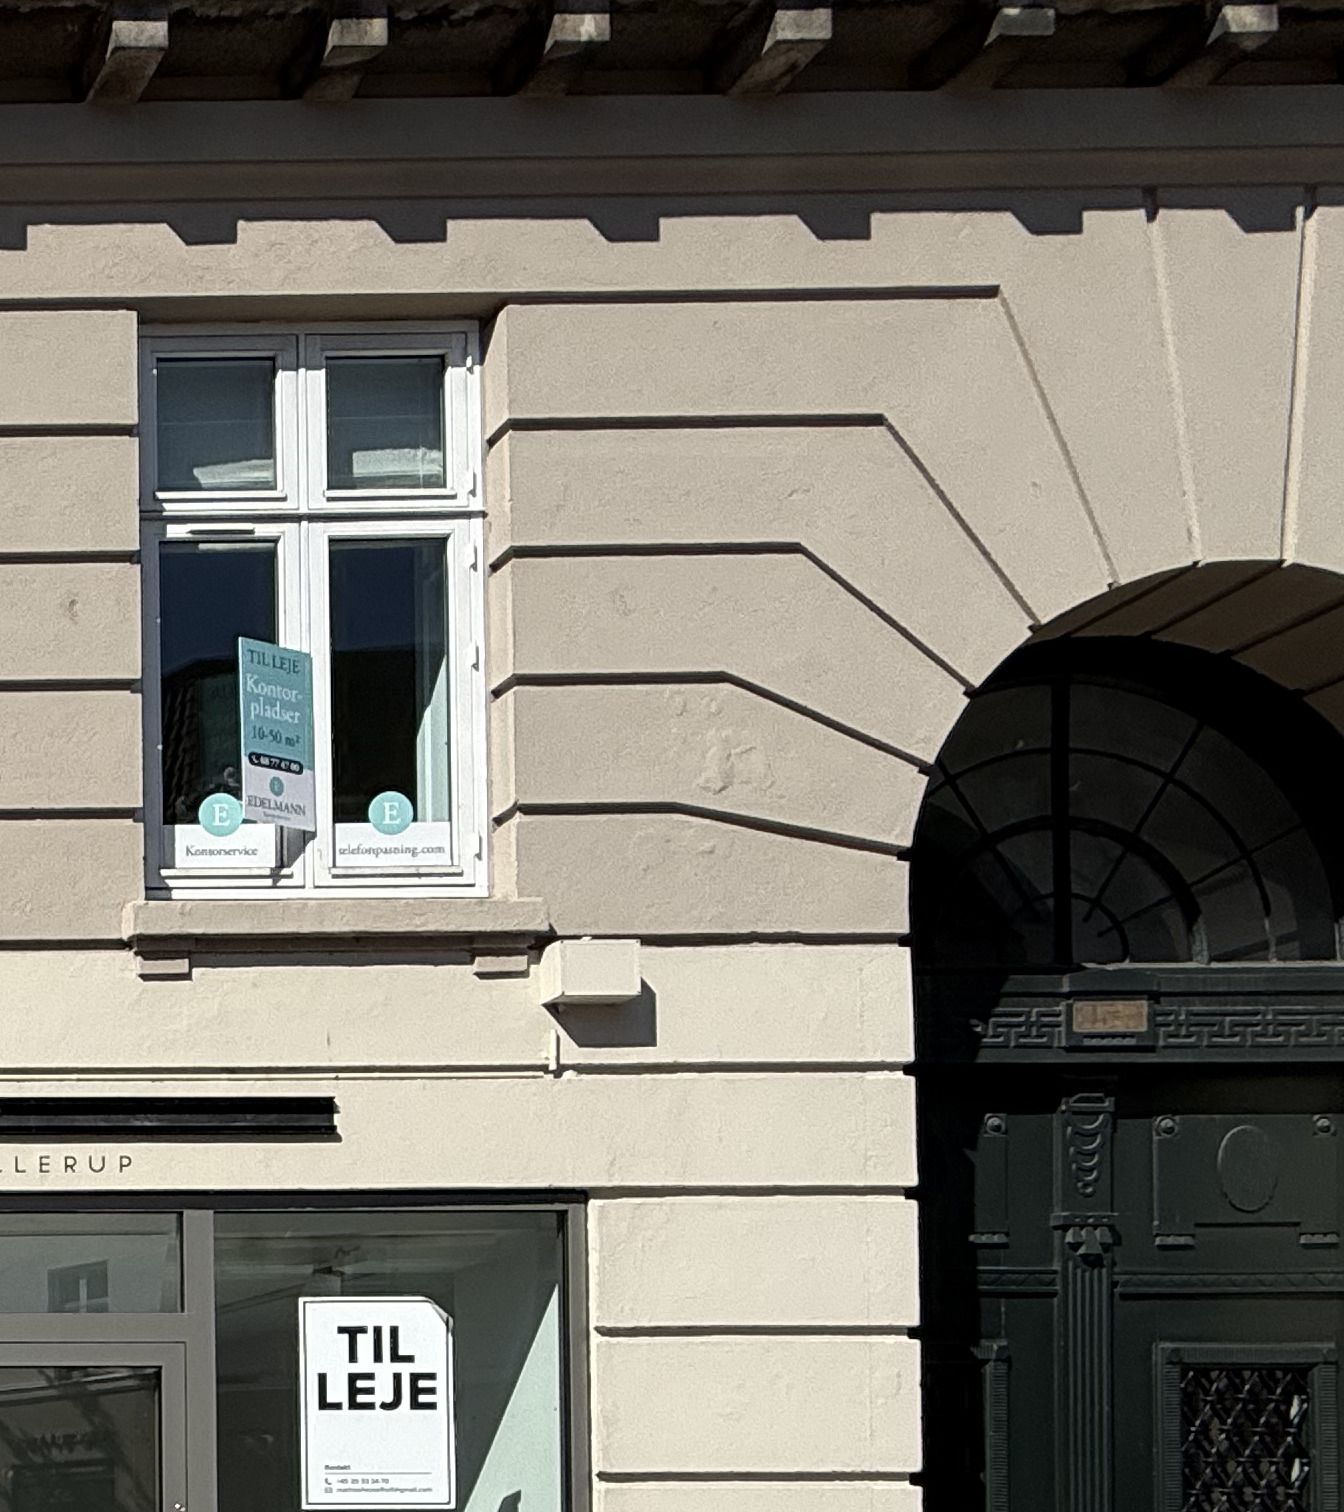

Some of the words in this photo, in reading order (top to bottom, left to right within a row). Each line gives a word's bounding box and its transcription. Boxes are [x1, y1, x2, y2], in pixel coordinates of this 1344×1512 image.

[247, 649, 270, 667] TIL
[272, 655, 301, 675] LEJE
[245, 673, 303, 702] Kontor-
[250, 697, 301, 724] pladser
[252, 725, 282, 744] 10-50
[270, 758, 280, 768] 77
[212, 804, 231, 826] E
[247, 795, 306, 817] EDELMANN
[383, 802, 401, 824] E
[185, 845, 258, 857] Kontorservice
[337, 1325, 415, 1363] TIL
[317, 1372, 438, 1411] LEJE
